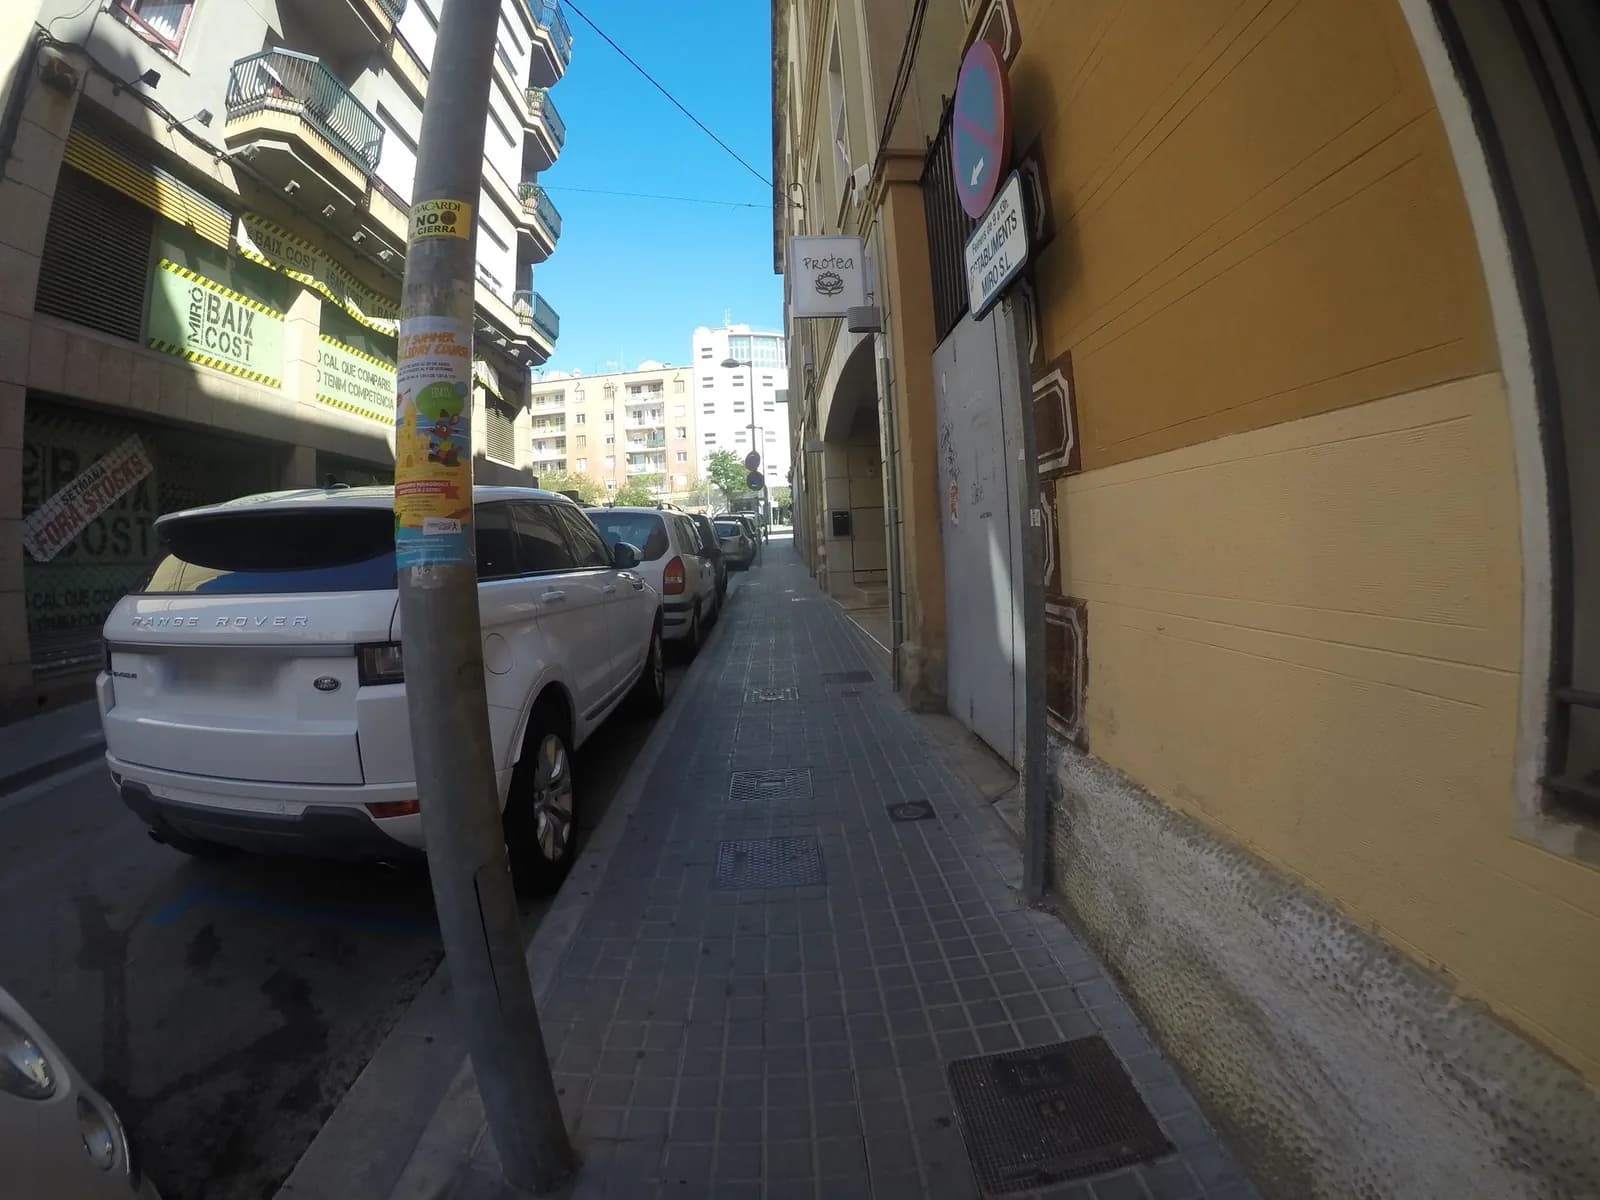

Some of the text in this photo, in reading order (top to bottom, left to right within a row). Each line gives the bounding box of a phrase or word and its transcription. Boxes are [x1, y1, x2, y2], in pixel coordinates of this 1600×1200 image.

[414, 201, 461, 215] BACARDI
[416, 213, 439, 228] NO
[417, 225, 457, 235] CIERRA
[993, 214, 997, 226] 9
[254, 230, 281, 256] BAIX
[286, 246, 316, 272] COST
[982, 264, 999, 298] MIRO
[207, 293, 255, 340] BAIX
[205, 327, 253, 361] COST
[323, 353, 339, 371] CAL
[341, 361, 357, 378] QUE
[323, 372, 347, 393] TENIM
[131, 616, 309, 628] RANGE ROVER
